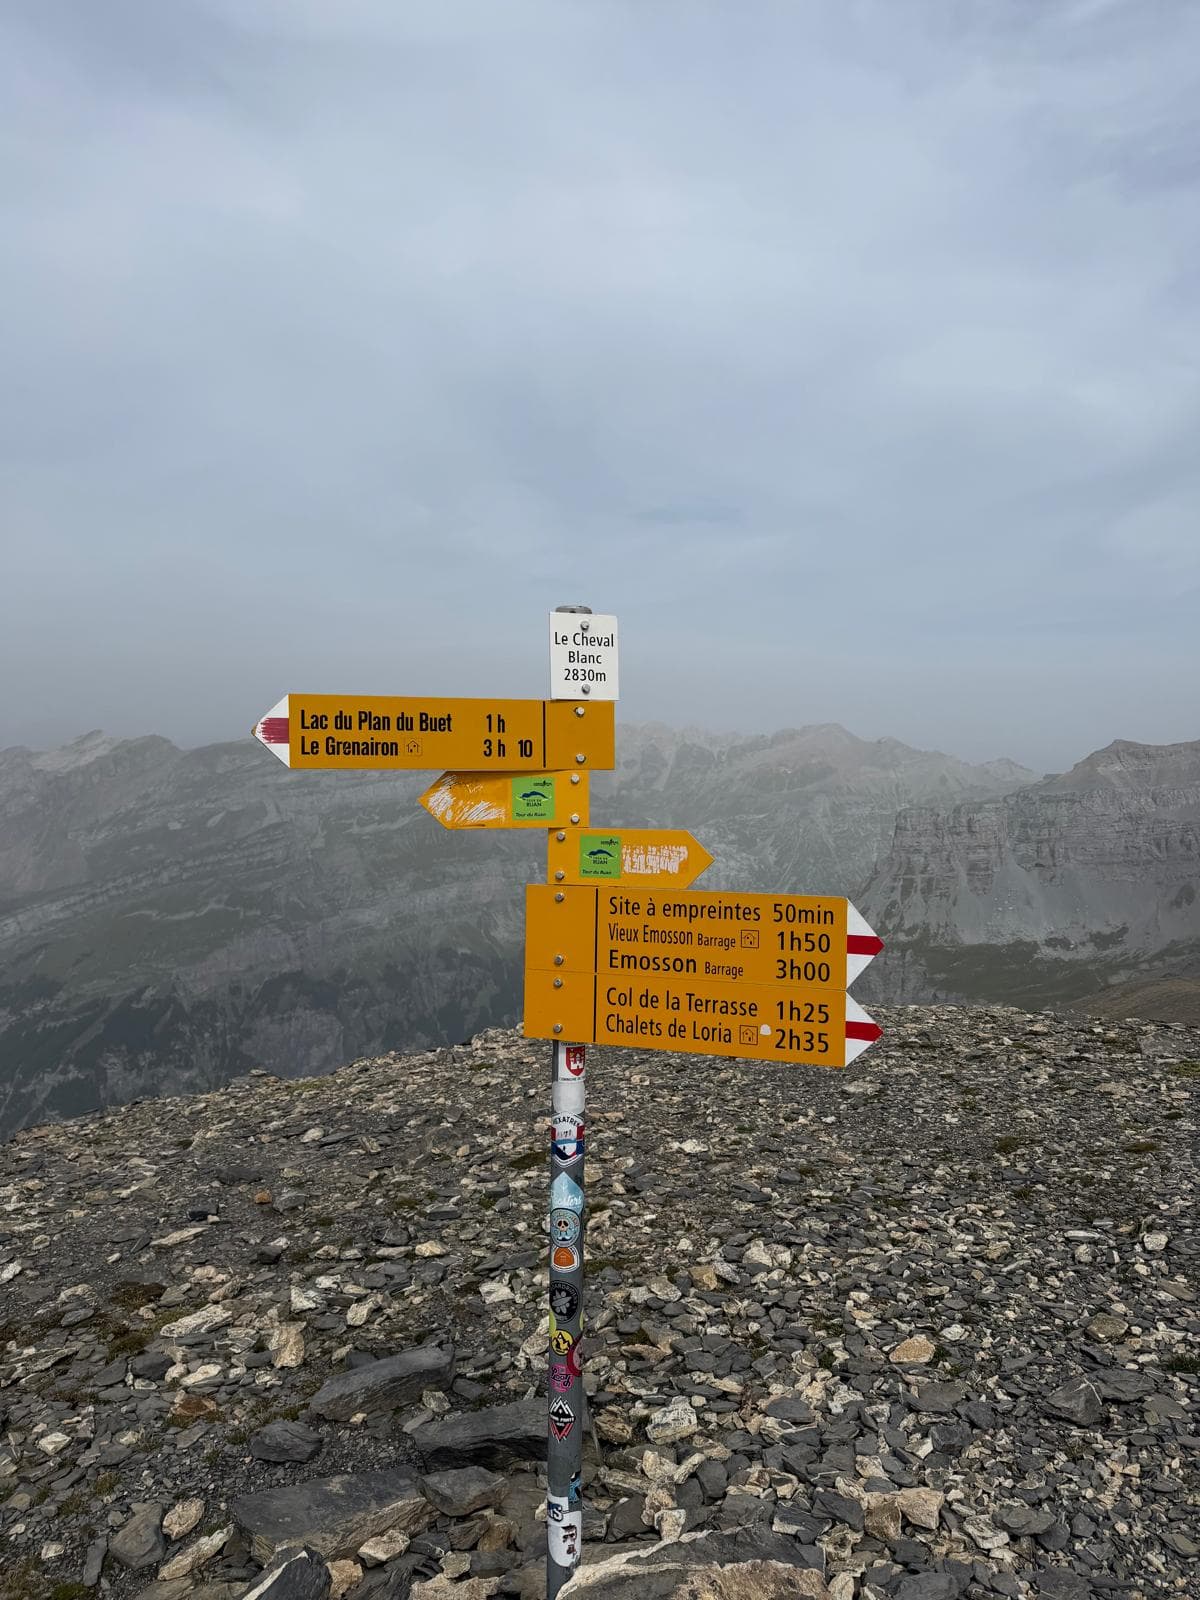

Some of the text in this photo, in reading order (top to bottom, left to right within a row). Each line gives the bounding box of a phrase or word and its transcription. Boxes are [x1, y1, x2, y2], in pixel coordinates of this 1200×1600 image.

[554, 631, 615, 649] Le Cheval
[568, 650, 602, 665] Blanc
[564, 668, 607, 682] 2830m
[300, 709, 506, 734] Lac du Plan du Buet 1 h
[300, 735, 533, 758] Le Grenairon 3 h 10
[609, 895, 834, 925] Site à empreintes 50min
[608, 922, 831, 954] Vieux Emosson Barrage 1h50
[609, 949, 831, 983] Emosson Barrage 3h00
[606, 987, 830, 1024] Col de la Terrasse 1h25
[605, 1013, 829, 1053] Chalets de Loria 2h35
